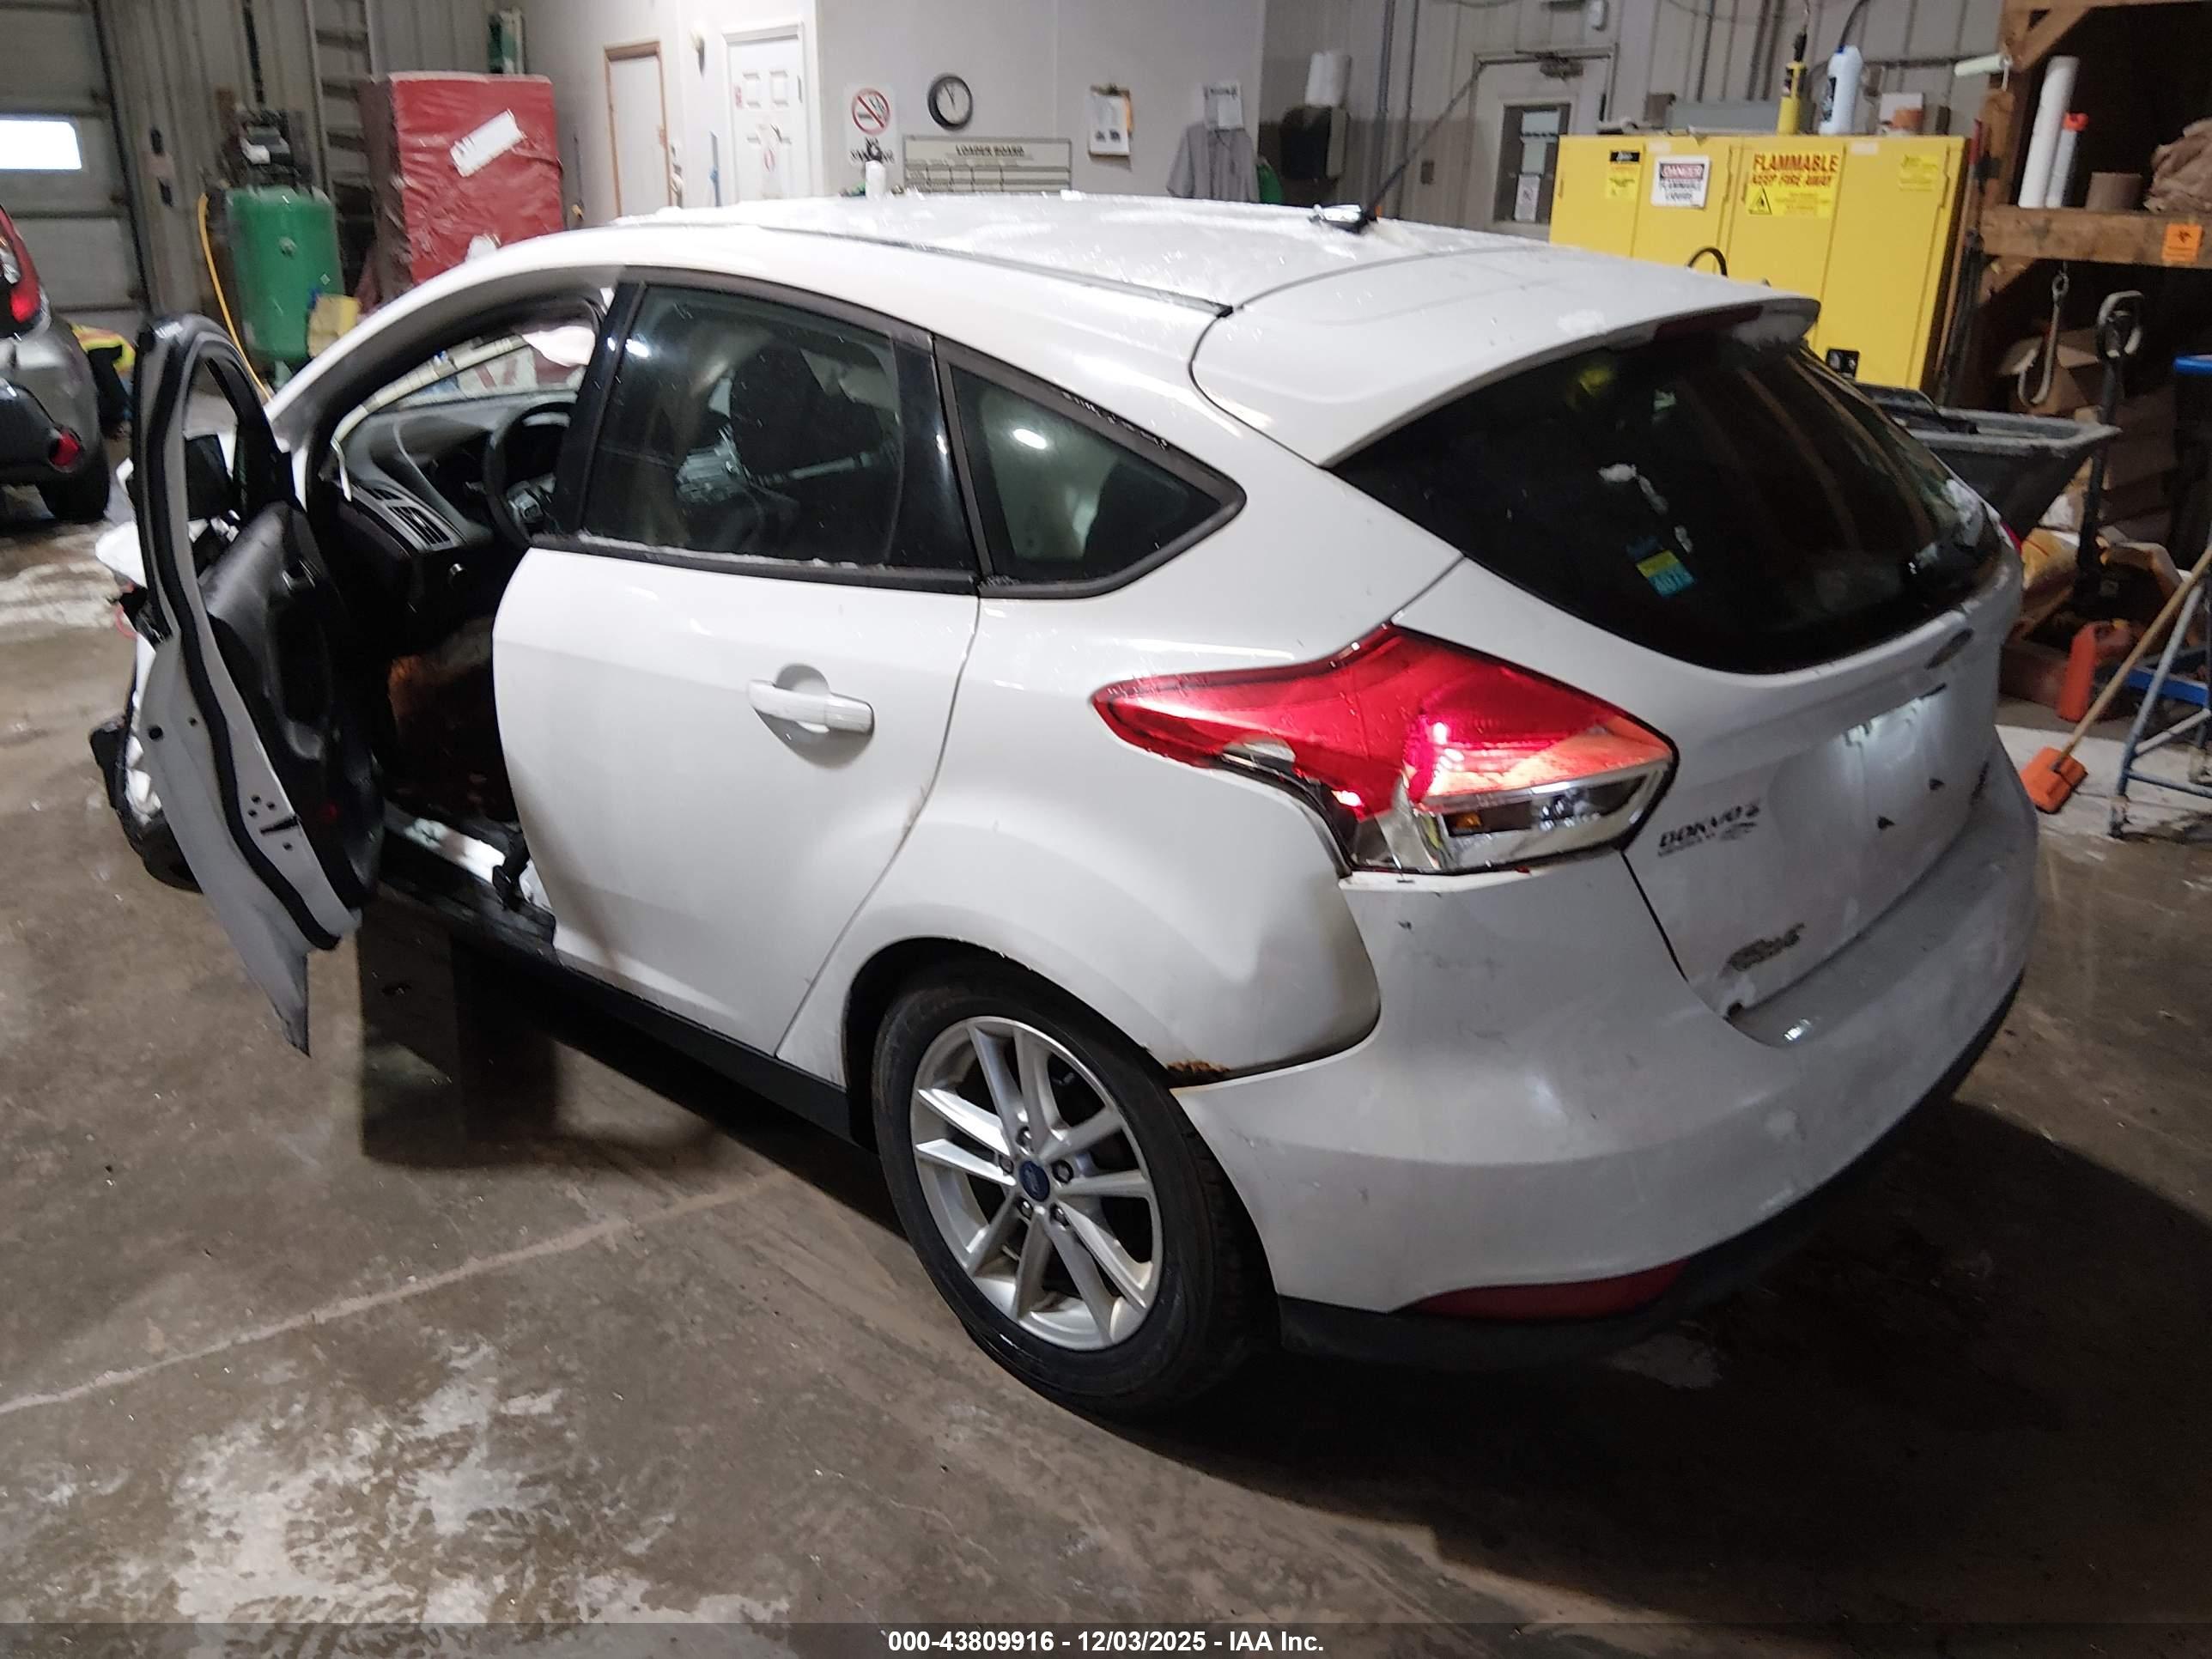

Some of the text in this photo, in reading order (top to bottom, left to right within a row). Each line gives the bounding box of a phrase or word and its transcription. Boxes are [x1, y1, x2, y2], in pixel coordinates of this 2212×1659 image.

[1753, 154, 1839, 173] FLAMMABLE
[1661, 164, 1703, 179] DANGER
[1780, 174, 1802, 186] FIRE
[1805, 175, 1832, 187] AWAY
